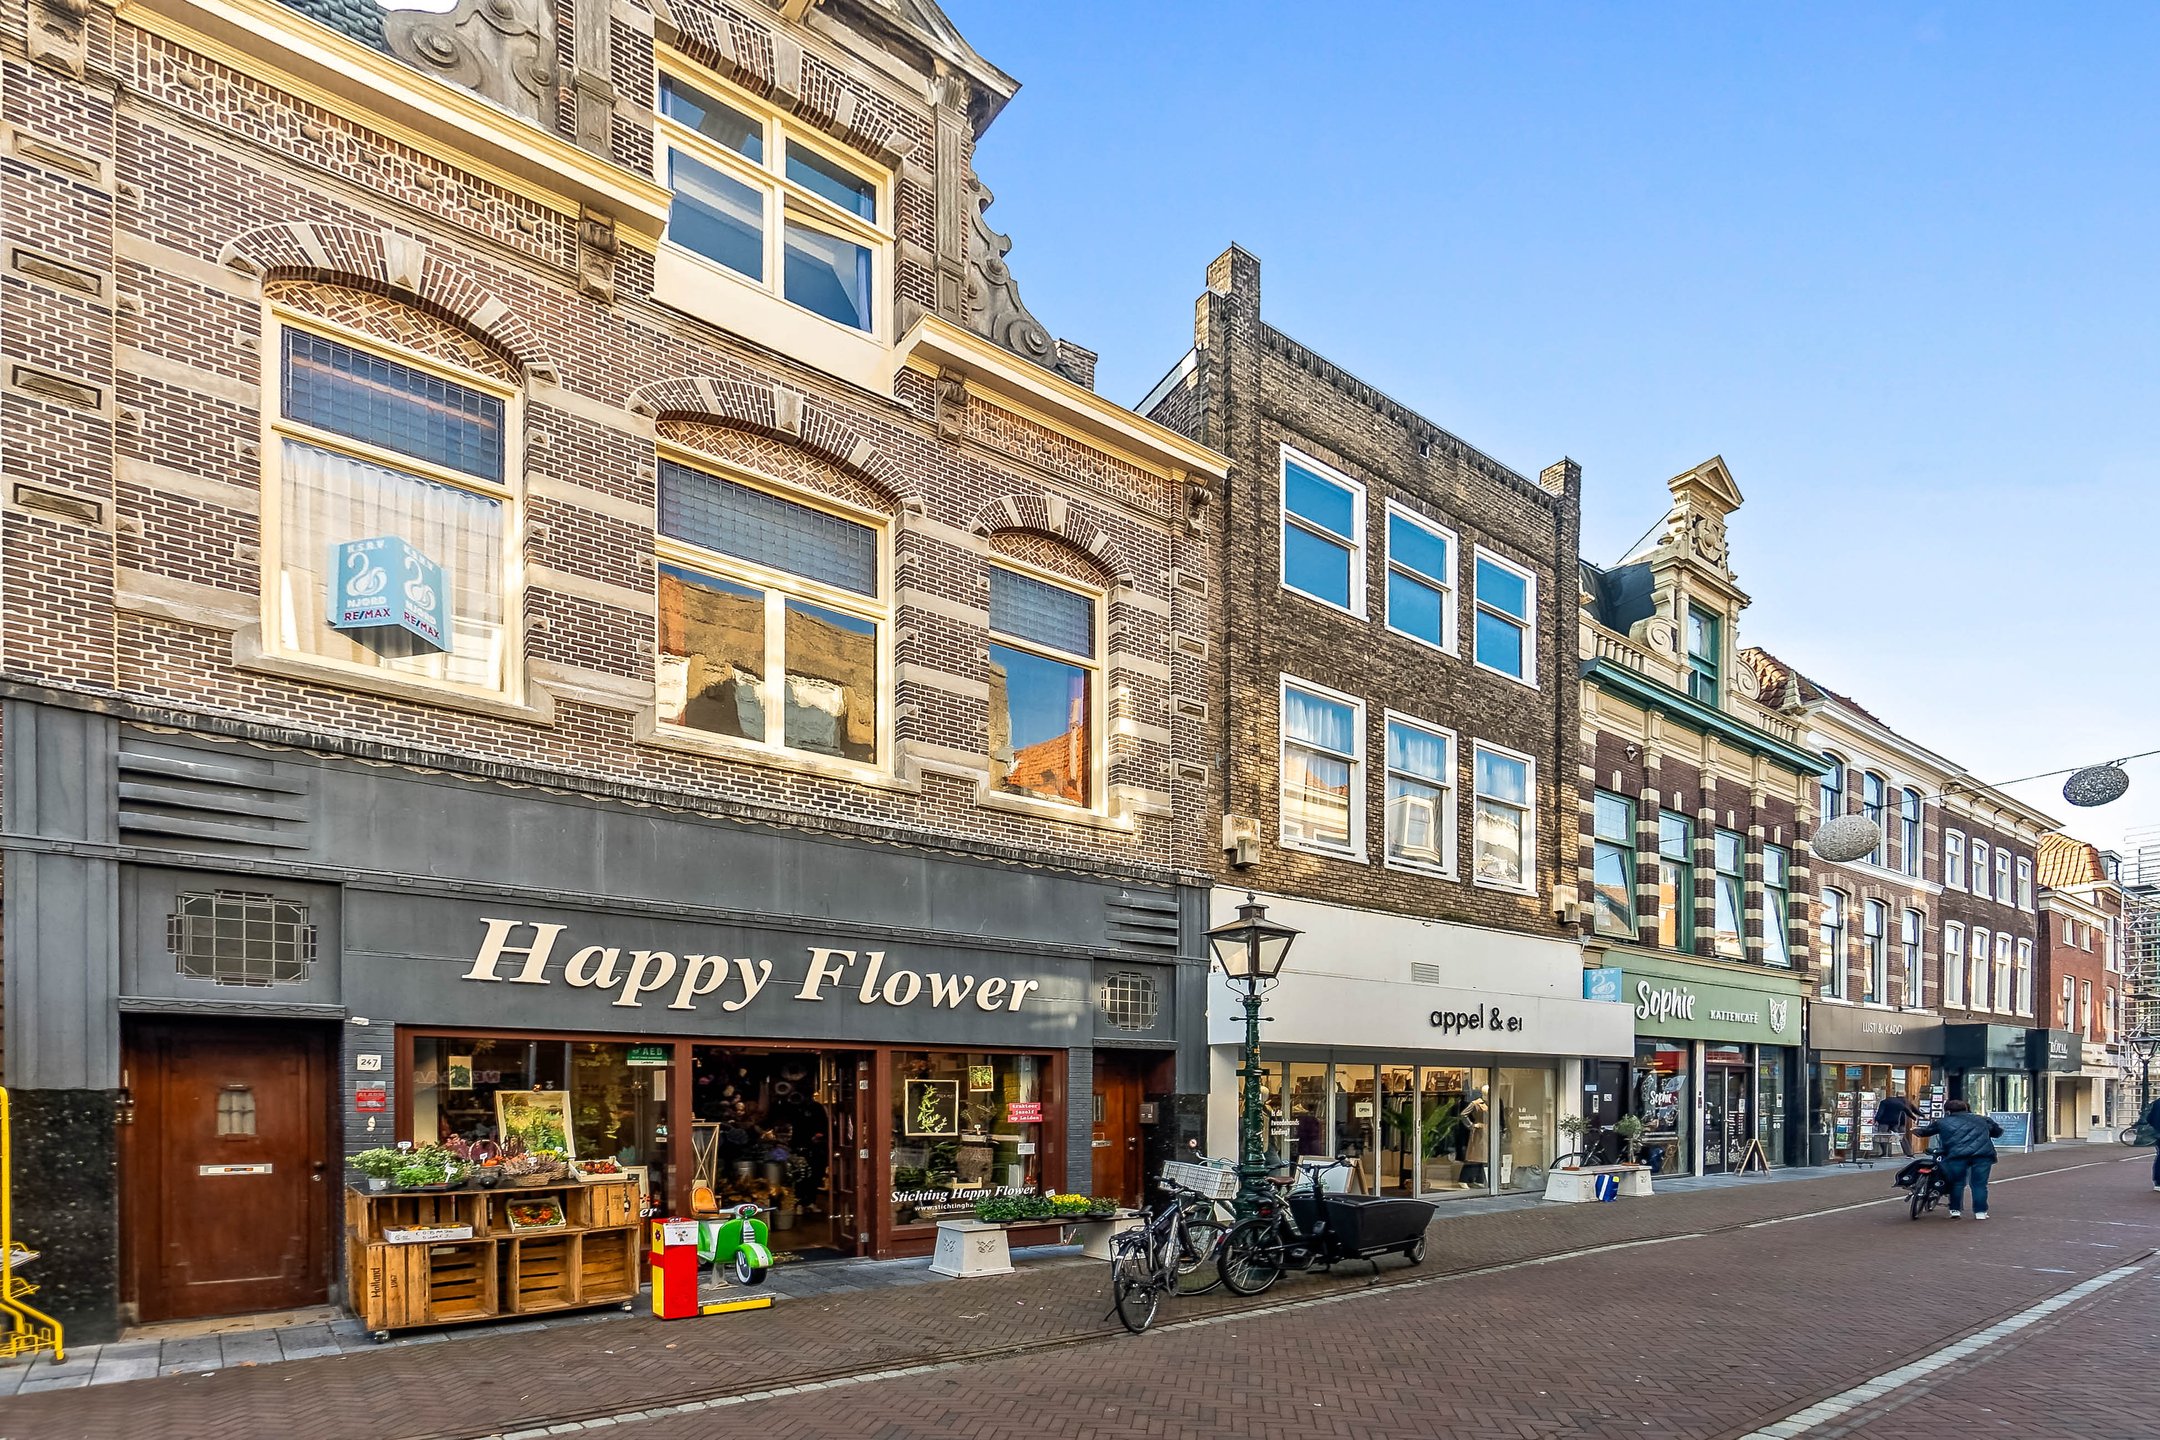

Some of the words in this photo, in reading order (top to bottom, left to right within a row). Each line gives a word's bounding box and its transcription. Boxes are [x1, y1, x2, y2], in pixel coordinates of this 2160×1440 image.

[344, 608, 391, 621] RE/MAX
[403, 611, 440, 640] RE/MAX
[461, 917, 774, 1012] Happy
[794, 946, 1039, 1012] Flower
[1636, 980, 1696, 1023] Sophie
[1430, 1003, 1484, 1035] appel
[1490, 1007, 1504, 1032] &
[1862, 1022, 1876, 1033] LUST
[1884, 1024, 1903, 1035] KADO
[642, 1047, 663, 1056] AED
[360, 1058, 378, 1068] 247
[1650, 1089, 1674, 1106] Sophie
[891, 1189, 949, 1203] Stichting
[951, 1188, 992, 1200] Happy
[994, 1185, 1036, 1197] Flower
[371, 1267, 382, 1298] Holland
